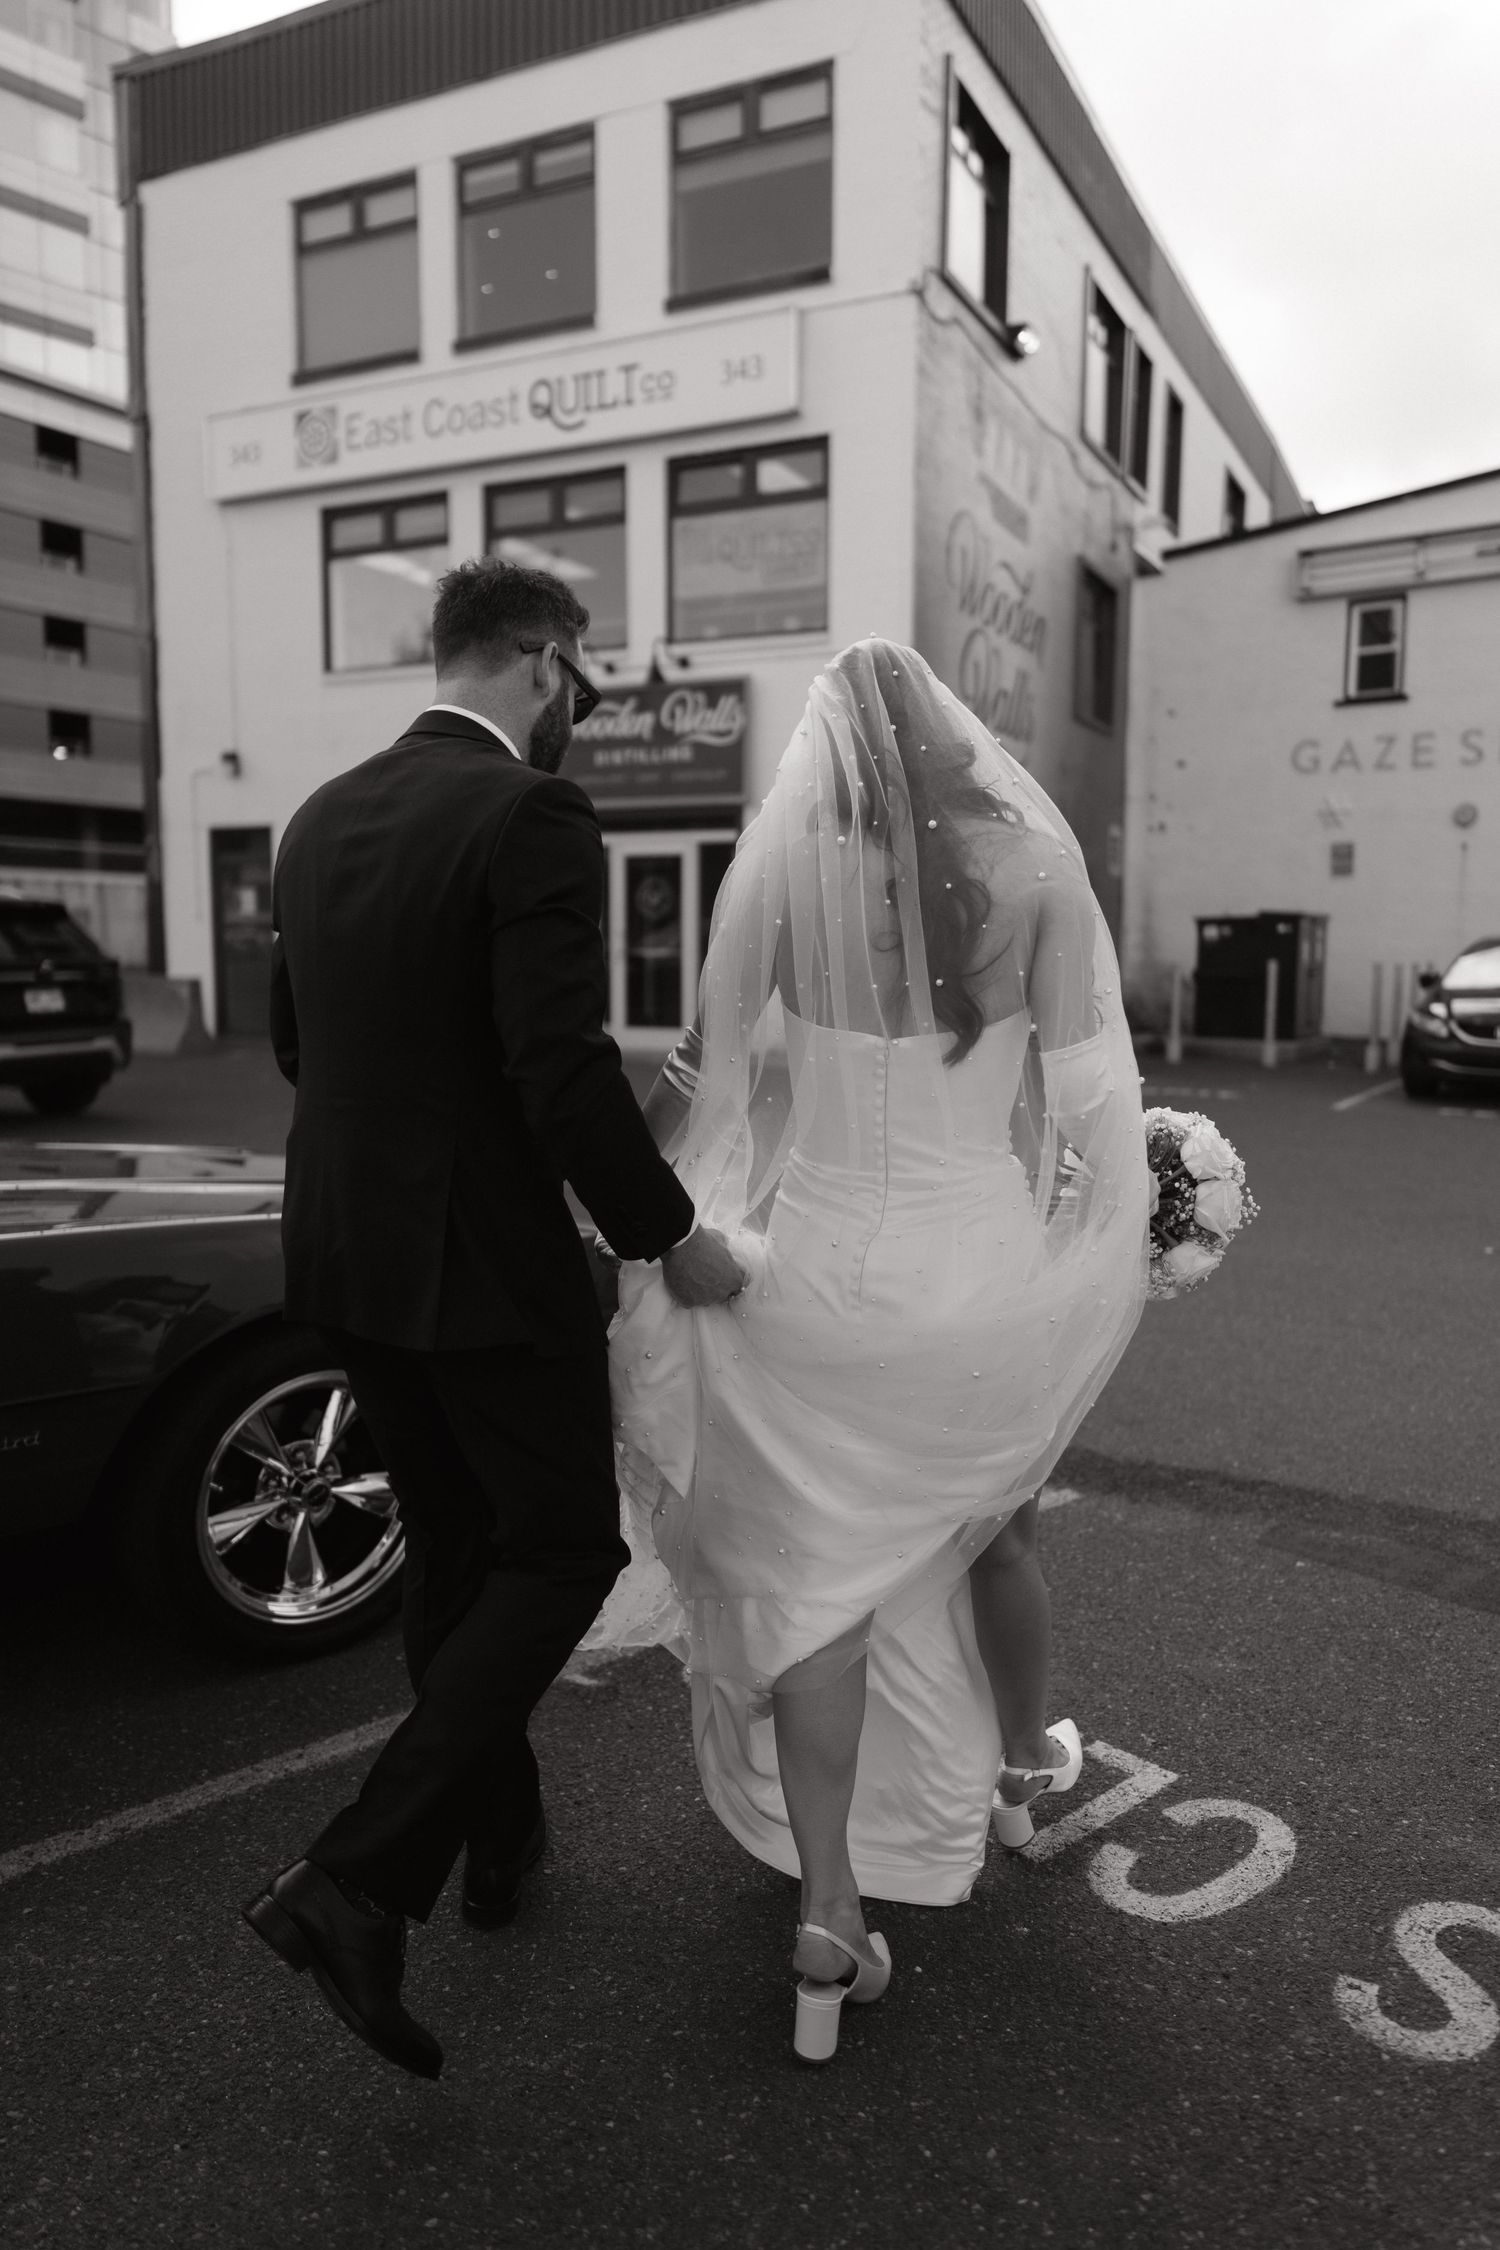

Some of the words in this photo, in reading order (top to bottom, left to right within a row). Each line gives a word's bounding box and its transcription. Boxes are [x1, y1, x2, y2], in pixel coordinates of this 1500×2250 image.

[720, 353, 766, 388] 343
[344, 405, 412, 451] East
[422, 387, 520, 440] Coast
[528, 362, 641, 433] QUILT
[572, 696, 655, 742] ooden
